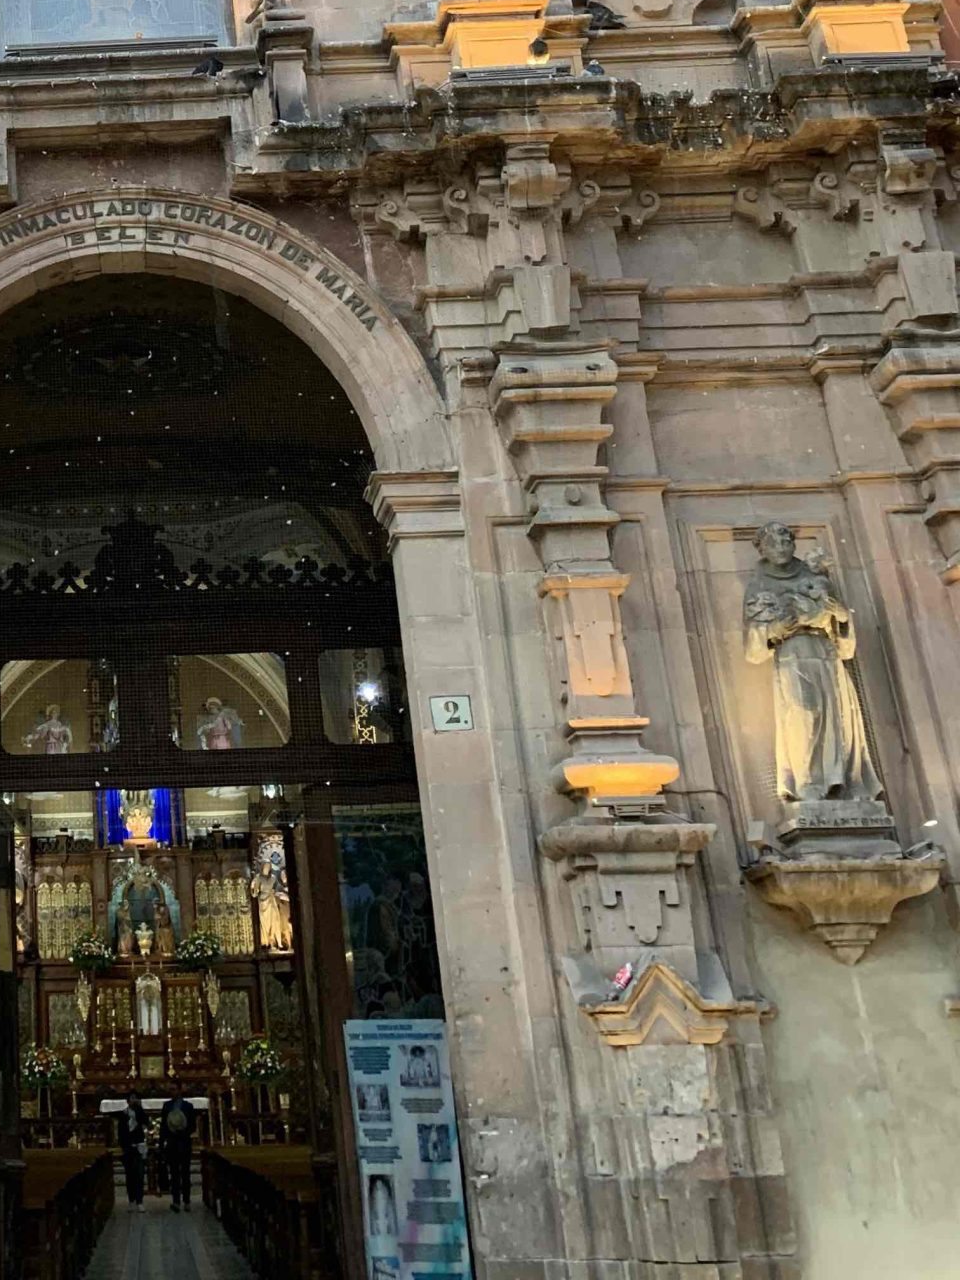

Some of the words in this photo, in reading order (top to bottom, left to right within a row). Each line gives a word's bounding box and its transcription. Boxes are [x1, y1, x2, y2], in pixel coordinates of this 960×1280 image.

[0, 199, 153, 247] INMACULADO
[163, 203, 275, 249] CORAZON
[279, 242, 315, 271] DE
[315, 269, 379, 333] MARIA
[68, 226, 190, 246] BELEN
